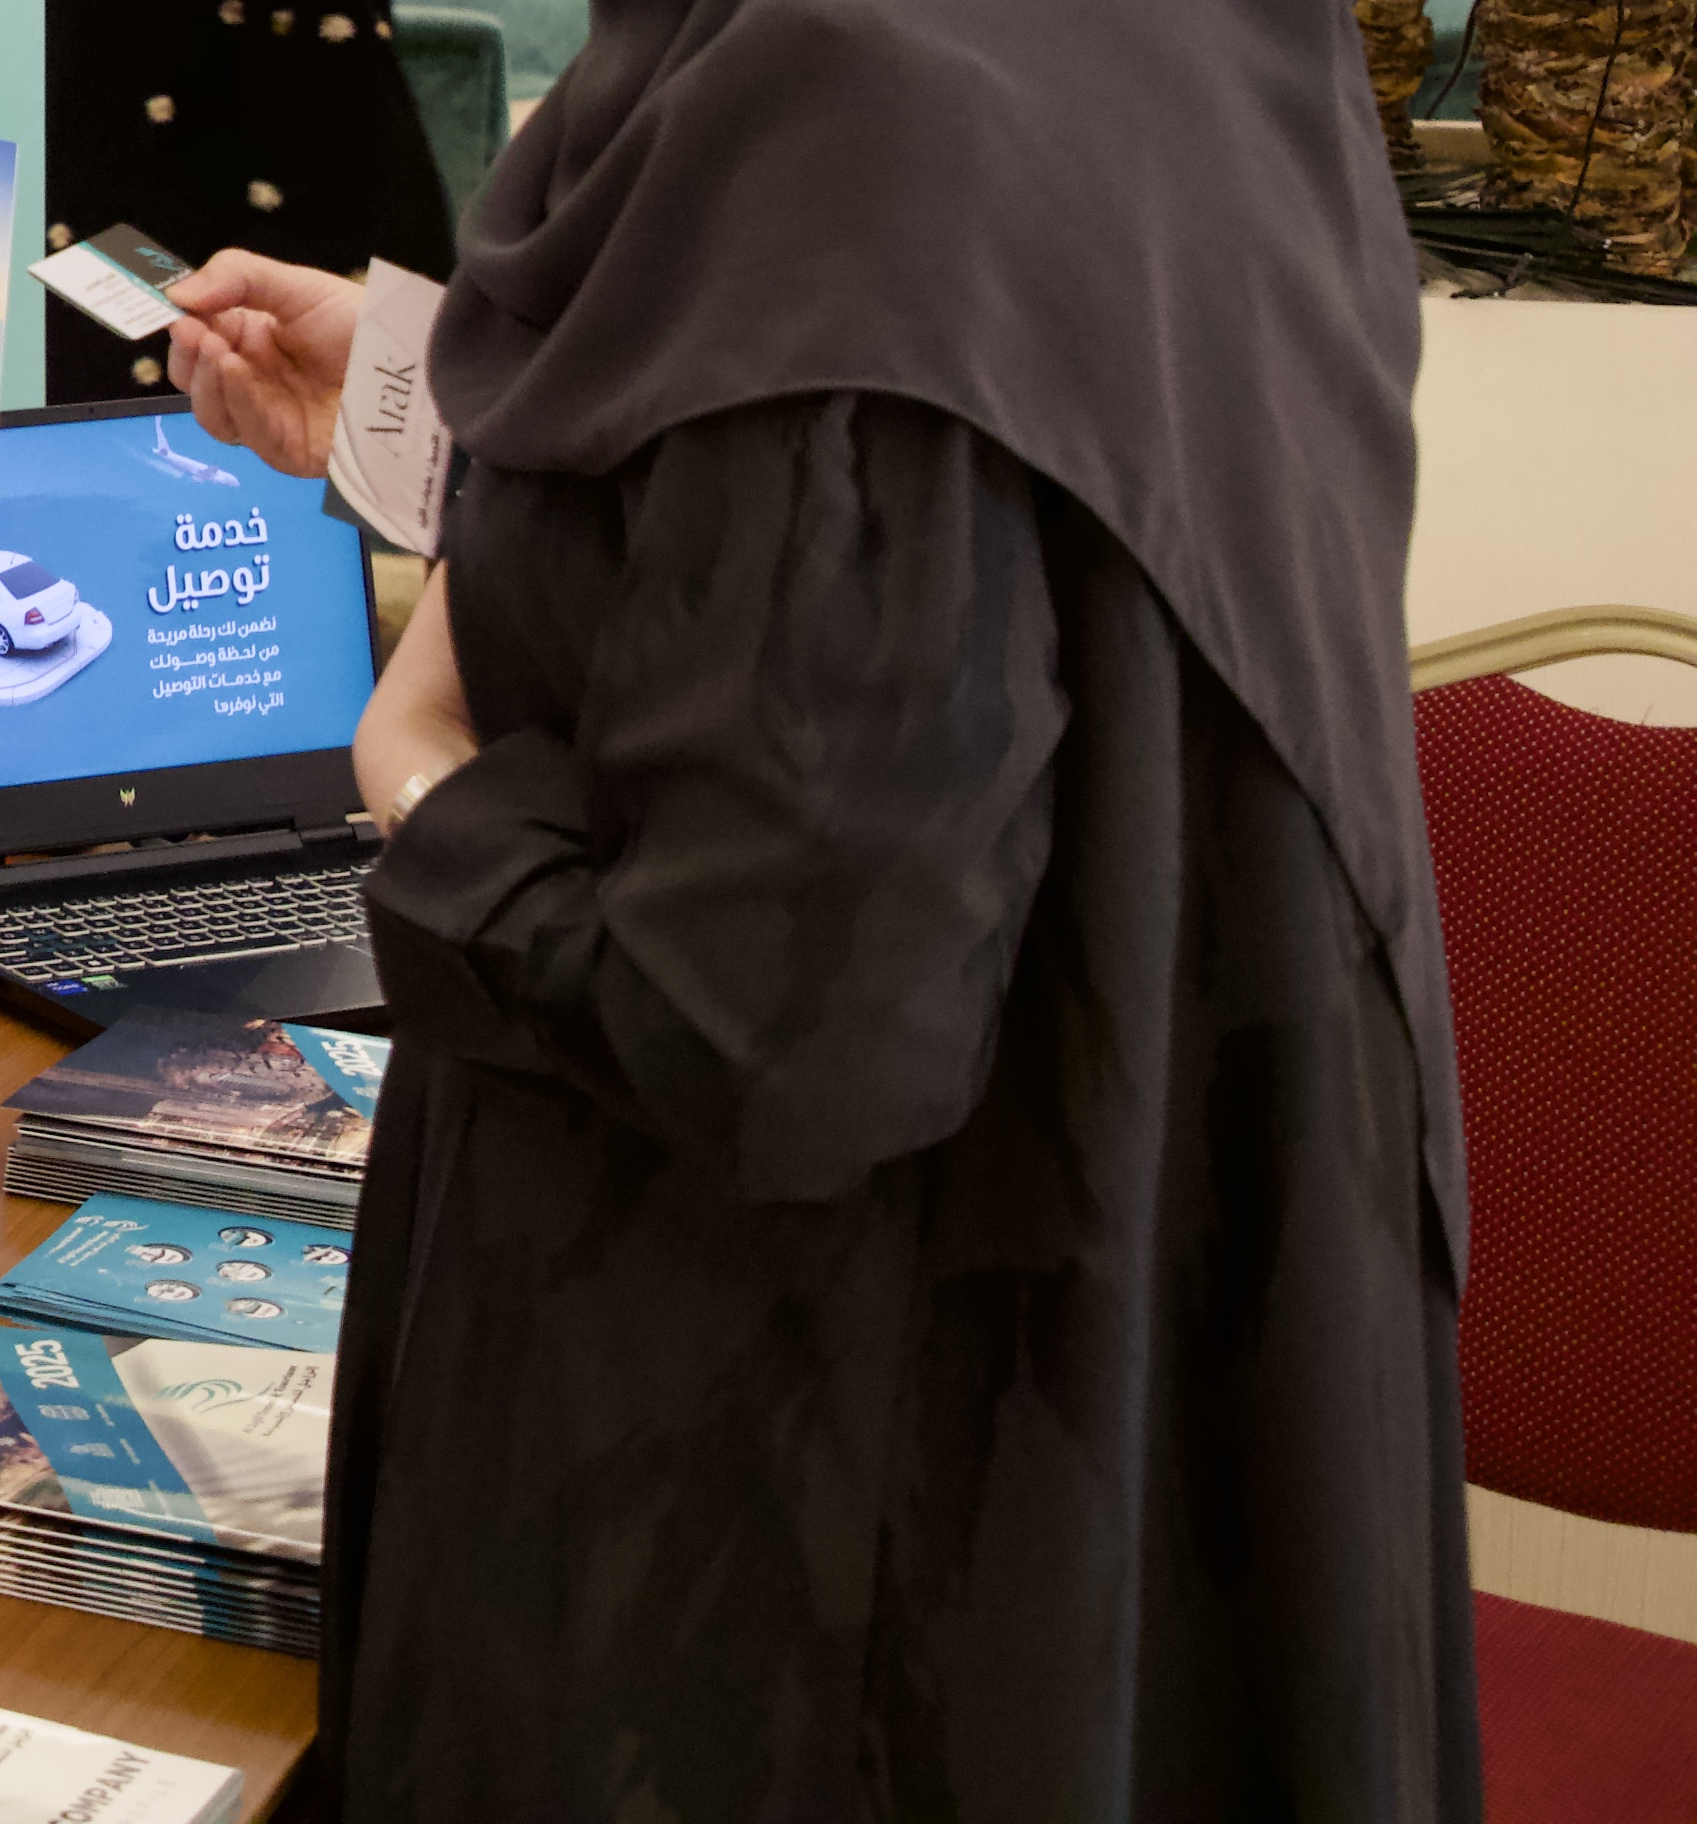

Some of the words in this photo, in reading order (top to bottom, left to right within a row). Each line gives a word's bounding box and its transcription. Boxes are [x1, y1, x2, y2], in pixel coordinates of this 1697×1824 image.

[175, 507, 268, 551] خدمة
[148, 554, 270, 613] توصيل
[147, 628, 187, 646] مريحة
[189, 624, 216, 642] رحلة
[217, 621, 236, 636] لك
[237, 616, 276, 638] نضمن
[217, 644, 256, 662] لحظة
[258, 644, 279, 661] من
[152, 674, 207, 699] التوصيل
[262, 669, 282, 686] مع
[213, 696, 257, 716] نوفرها
[258, 692, 284, 716] التي
[321, 1039, 383, 1077] 2025
[14, 1339, 81, 1390] 2025
[48, 1749, 150, 1824] OMPANY
